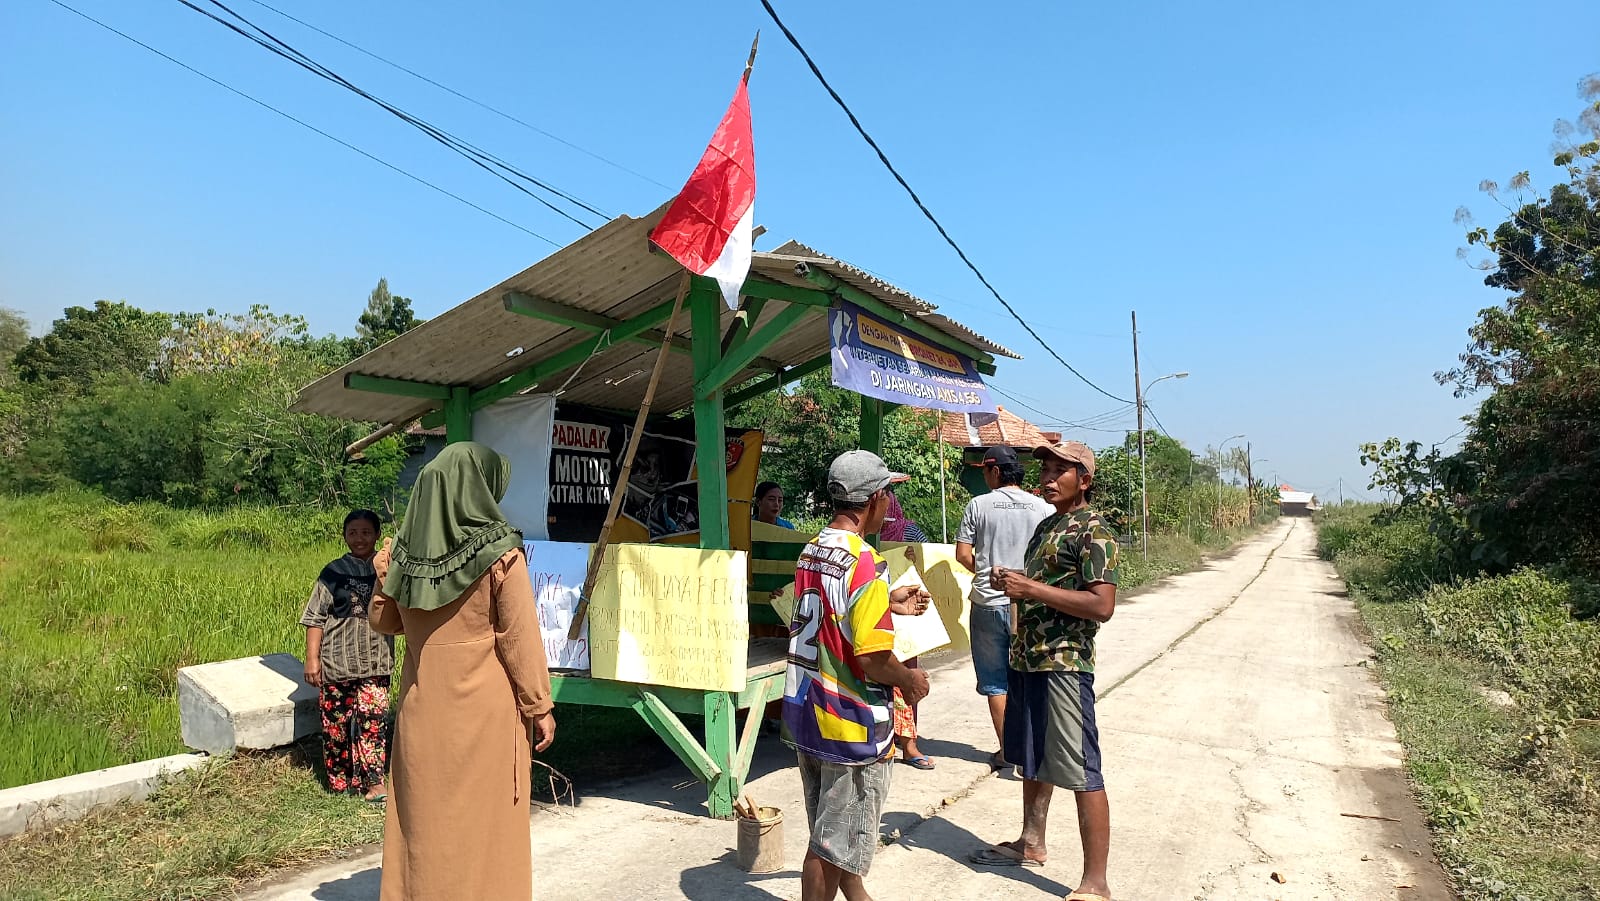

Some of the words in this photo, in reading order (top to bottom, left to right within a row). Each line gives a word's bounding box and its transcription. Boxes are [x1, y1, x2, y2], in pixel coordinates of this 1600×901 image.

[861, 322, 889, 343] DENGAN
[850, 345, 897, 371] INTERNETAN
[871, 369, 883, 389] DI
[885, 374, 938, 400] JARINGAN
[937, 386, 959, 404] AXIS
[555, 454, 611, 485] MOTOR
[586, 486, 611, 504] KITA
